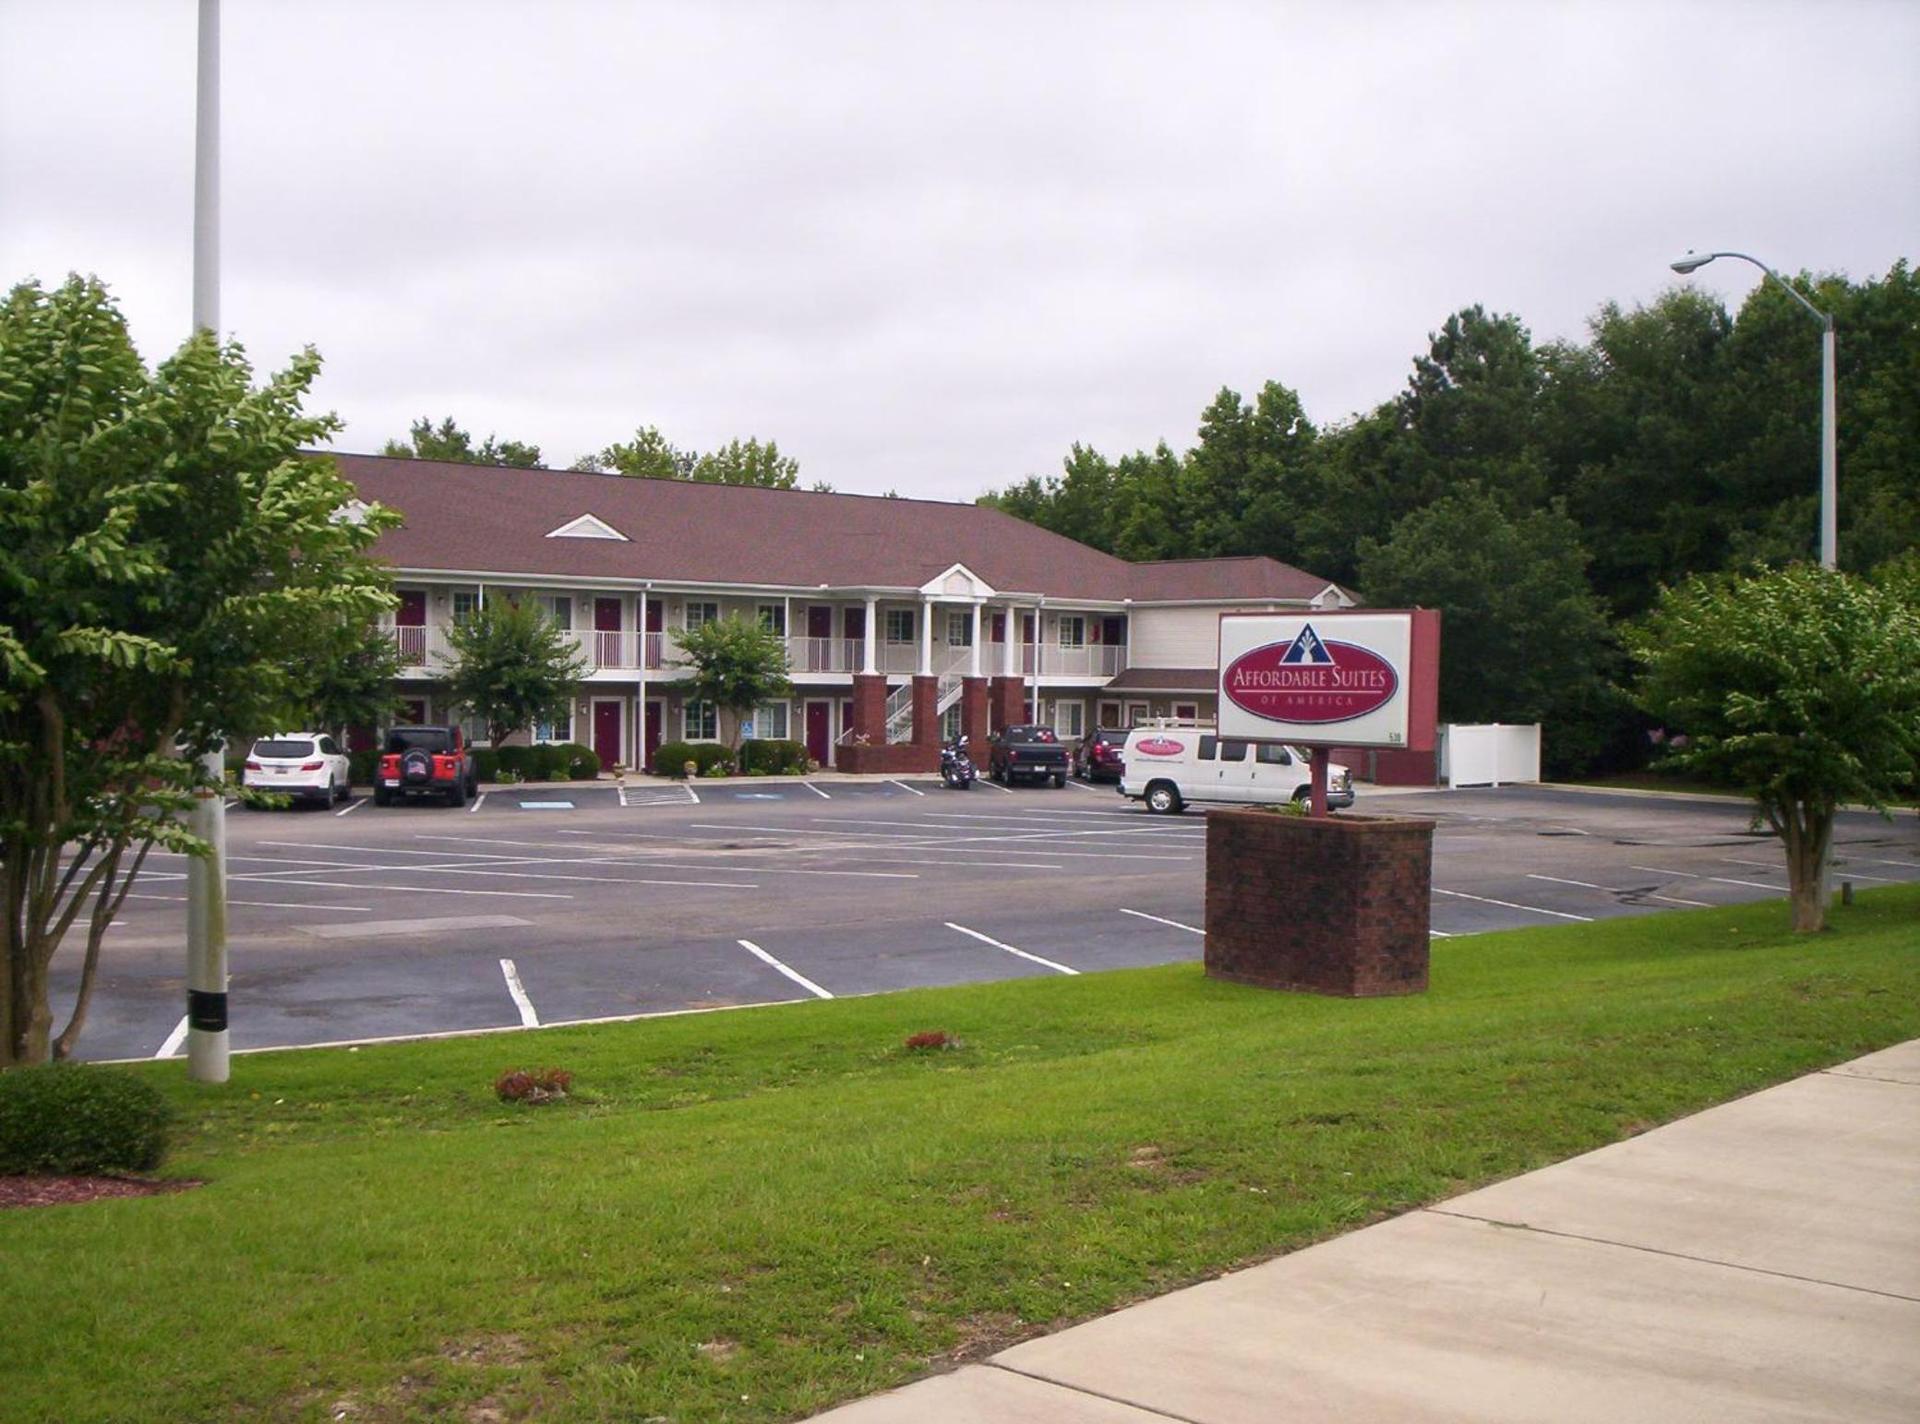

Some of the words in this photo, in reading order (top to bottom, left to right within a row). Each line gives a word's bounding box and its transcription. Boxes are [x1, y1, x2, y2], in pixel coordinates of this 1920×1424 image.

[1233, 667, 1326, 686] AFFORDABLE
[1331, 665, 1386, 687] SUITES
[1260, 695, 1276, 705] OF
[1287, 695, 1353, 706] AMERICA
